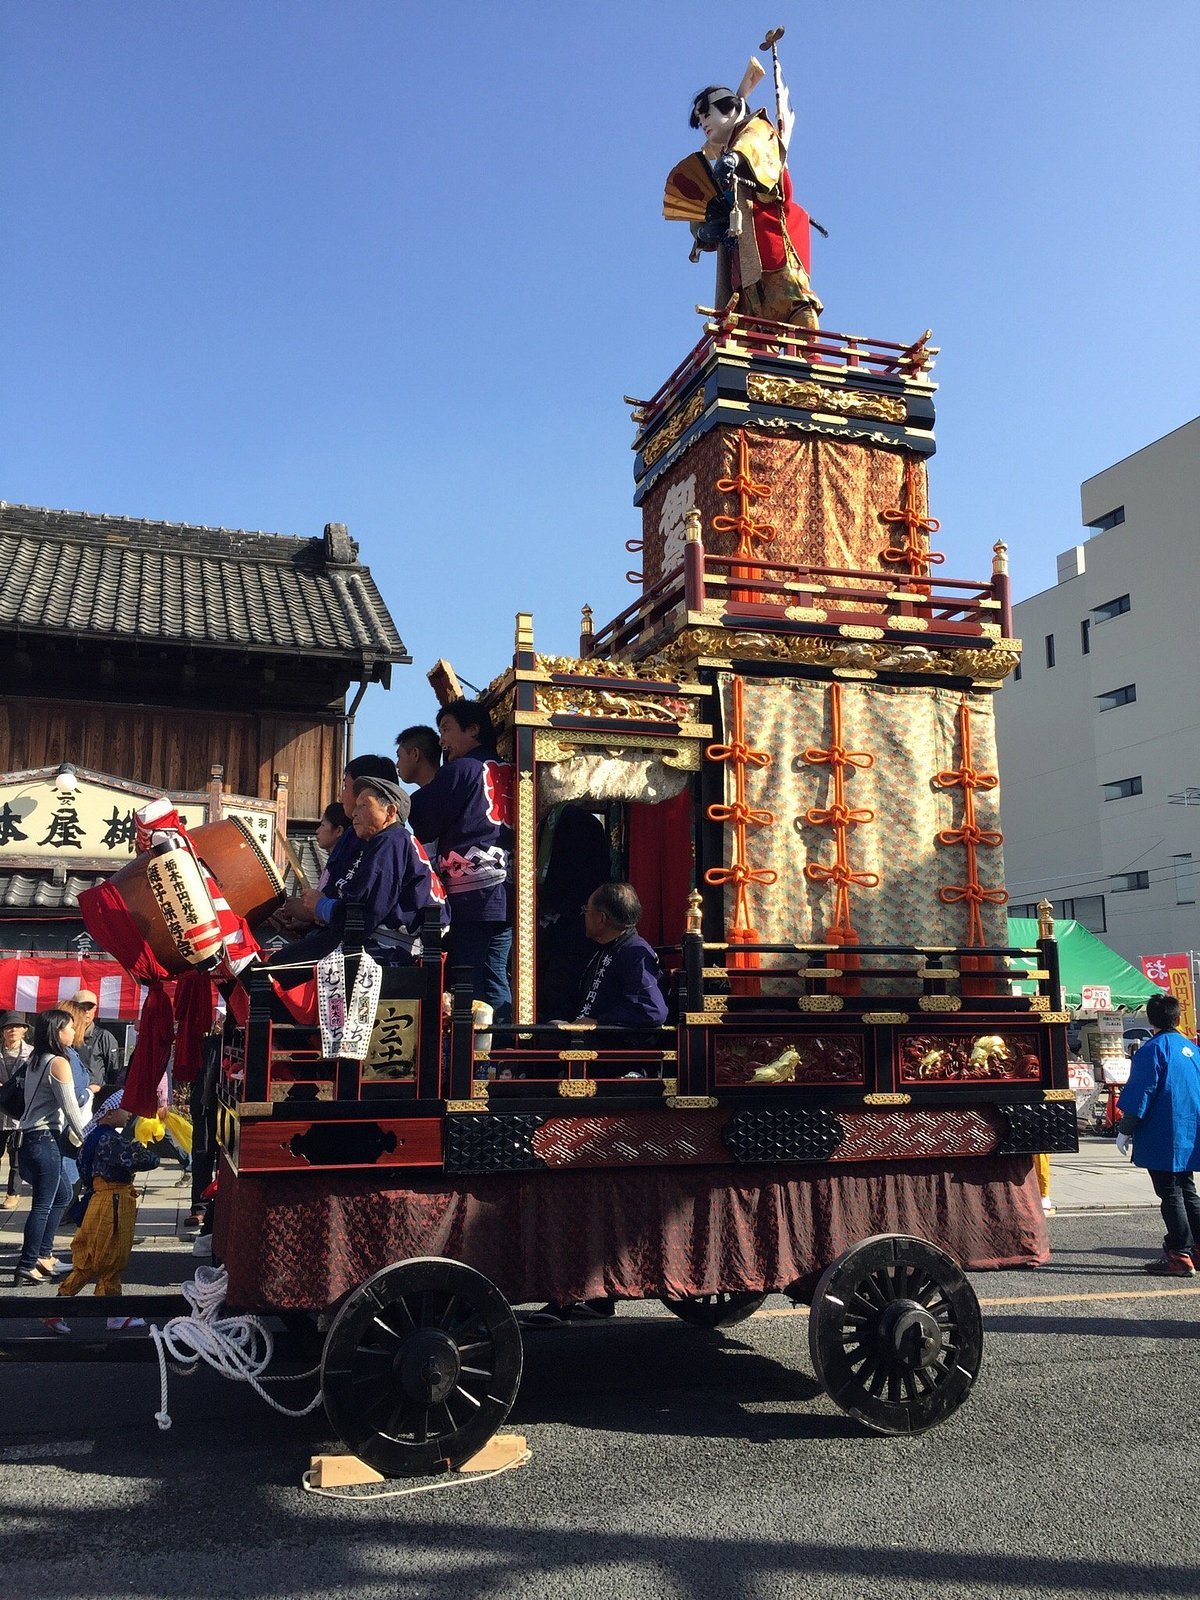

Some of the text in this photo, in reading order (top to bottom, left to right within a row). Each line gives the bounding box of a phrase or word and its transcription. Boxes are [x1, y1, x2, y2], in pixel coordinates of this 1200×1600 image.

[164, 858, 199, 925] 栃木市円光寺
[1092, 998, 1107, 1008] 70
[1075, 1077, 1090, 1087] 70
